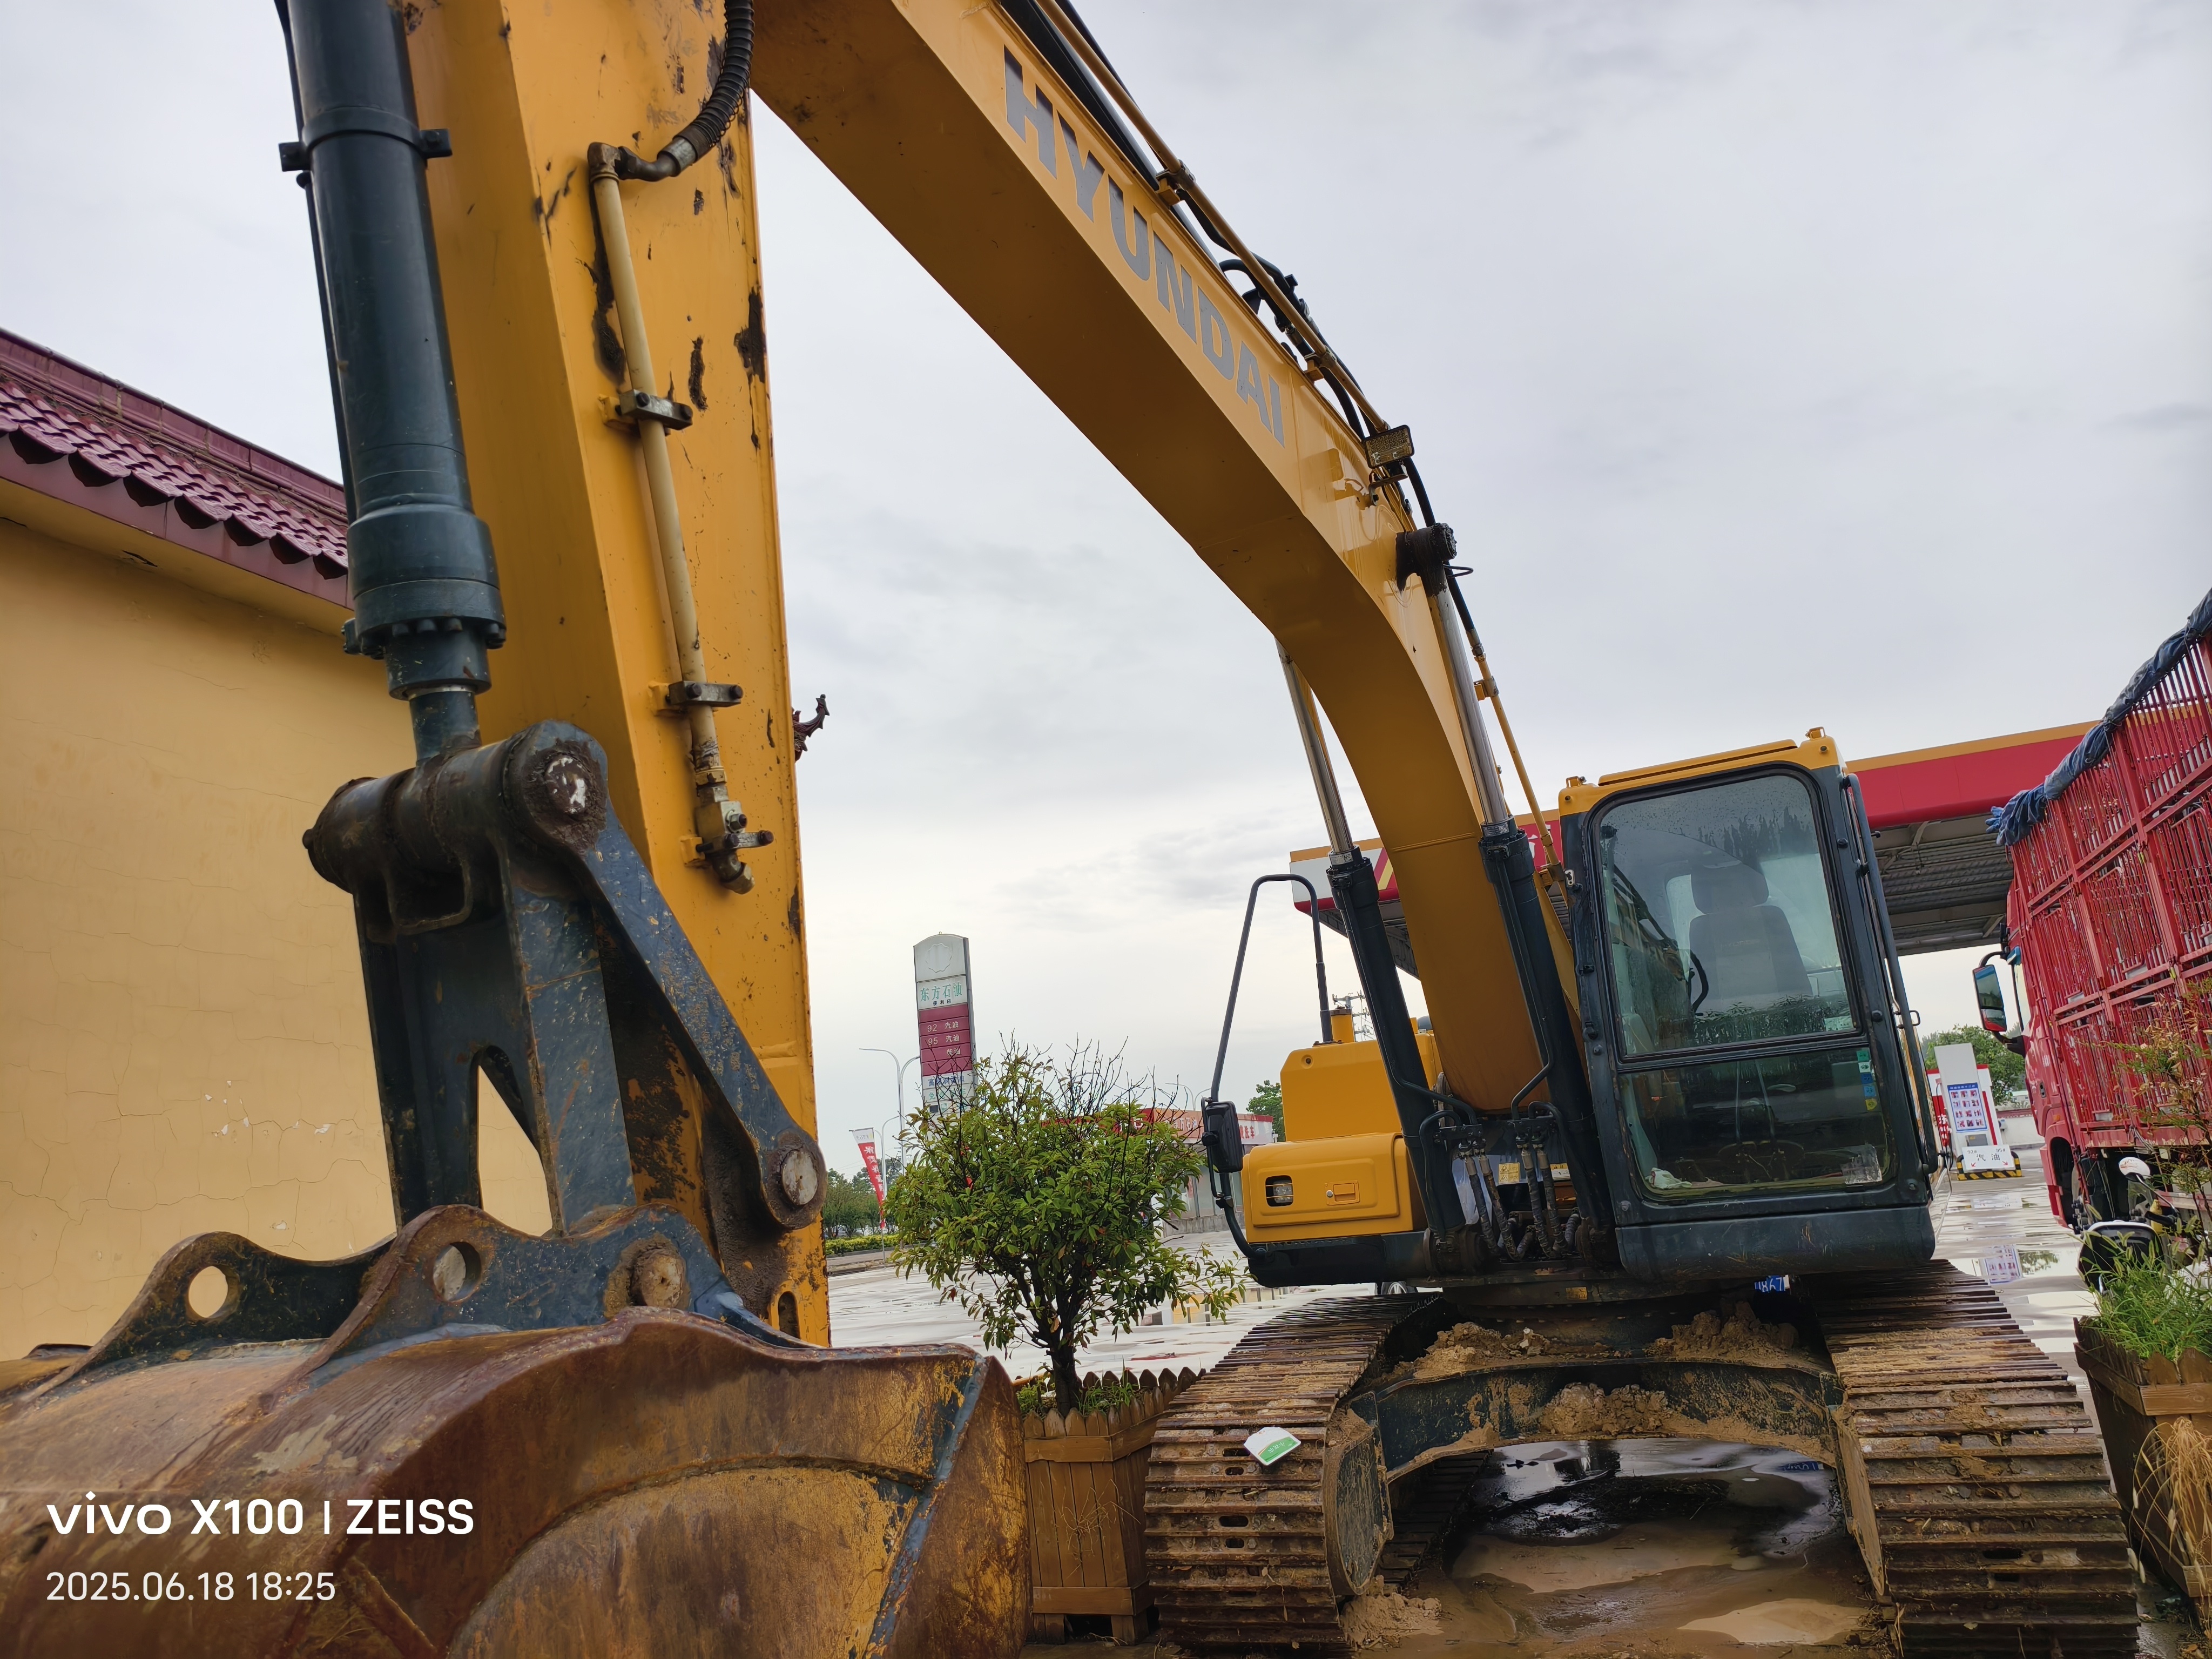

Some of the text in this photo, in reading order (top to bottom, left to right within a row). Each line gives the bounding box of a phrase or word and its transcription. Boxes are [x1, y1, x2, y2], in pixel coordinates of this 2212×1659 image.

[1003, 44, 1285, 448] HYUNDAI
[920, 982, 962, 1002] 东方石油
[927, 1021, 959, 1033] 92 汽油
[928, 1034, 960, 1046] 95 汽油
[947, 1048, 961, 1056] 柴油
[1977, 1153, 2000, 1161] 汽油
